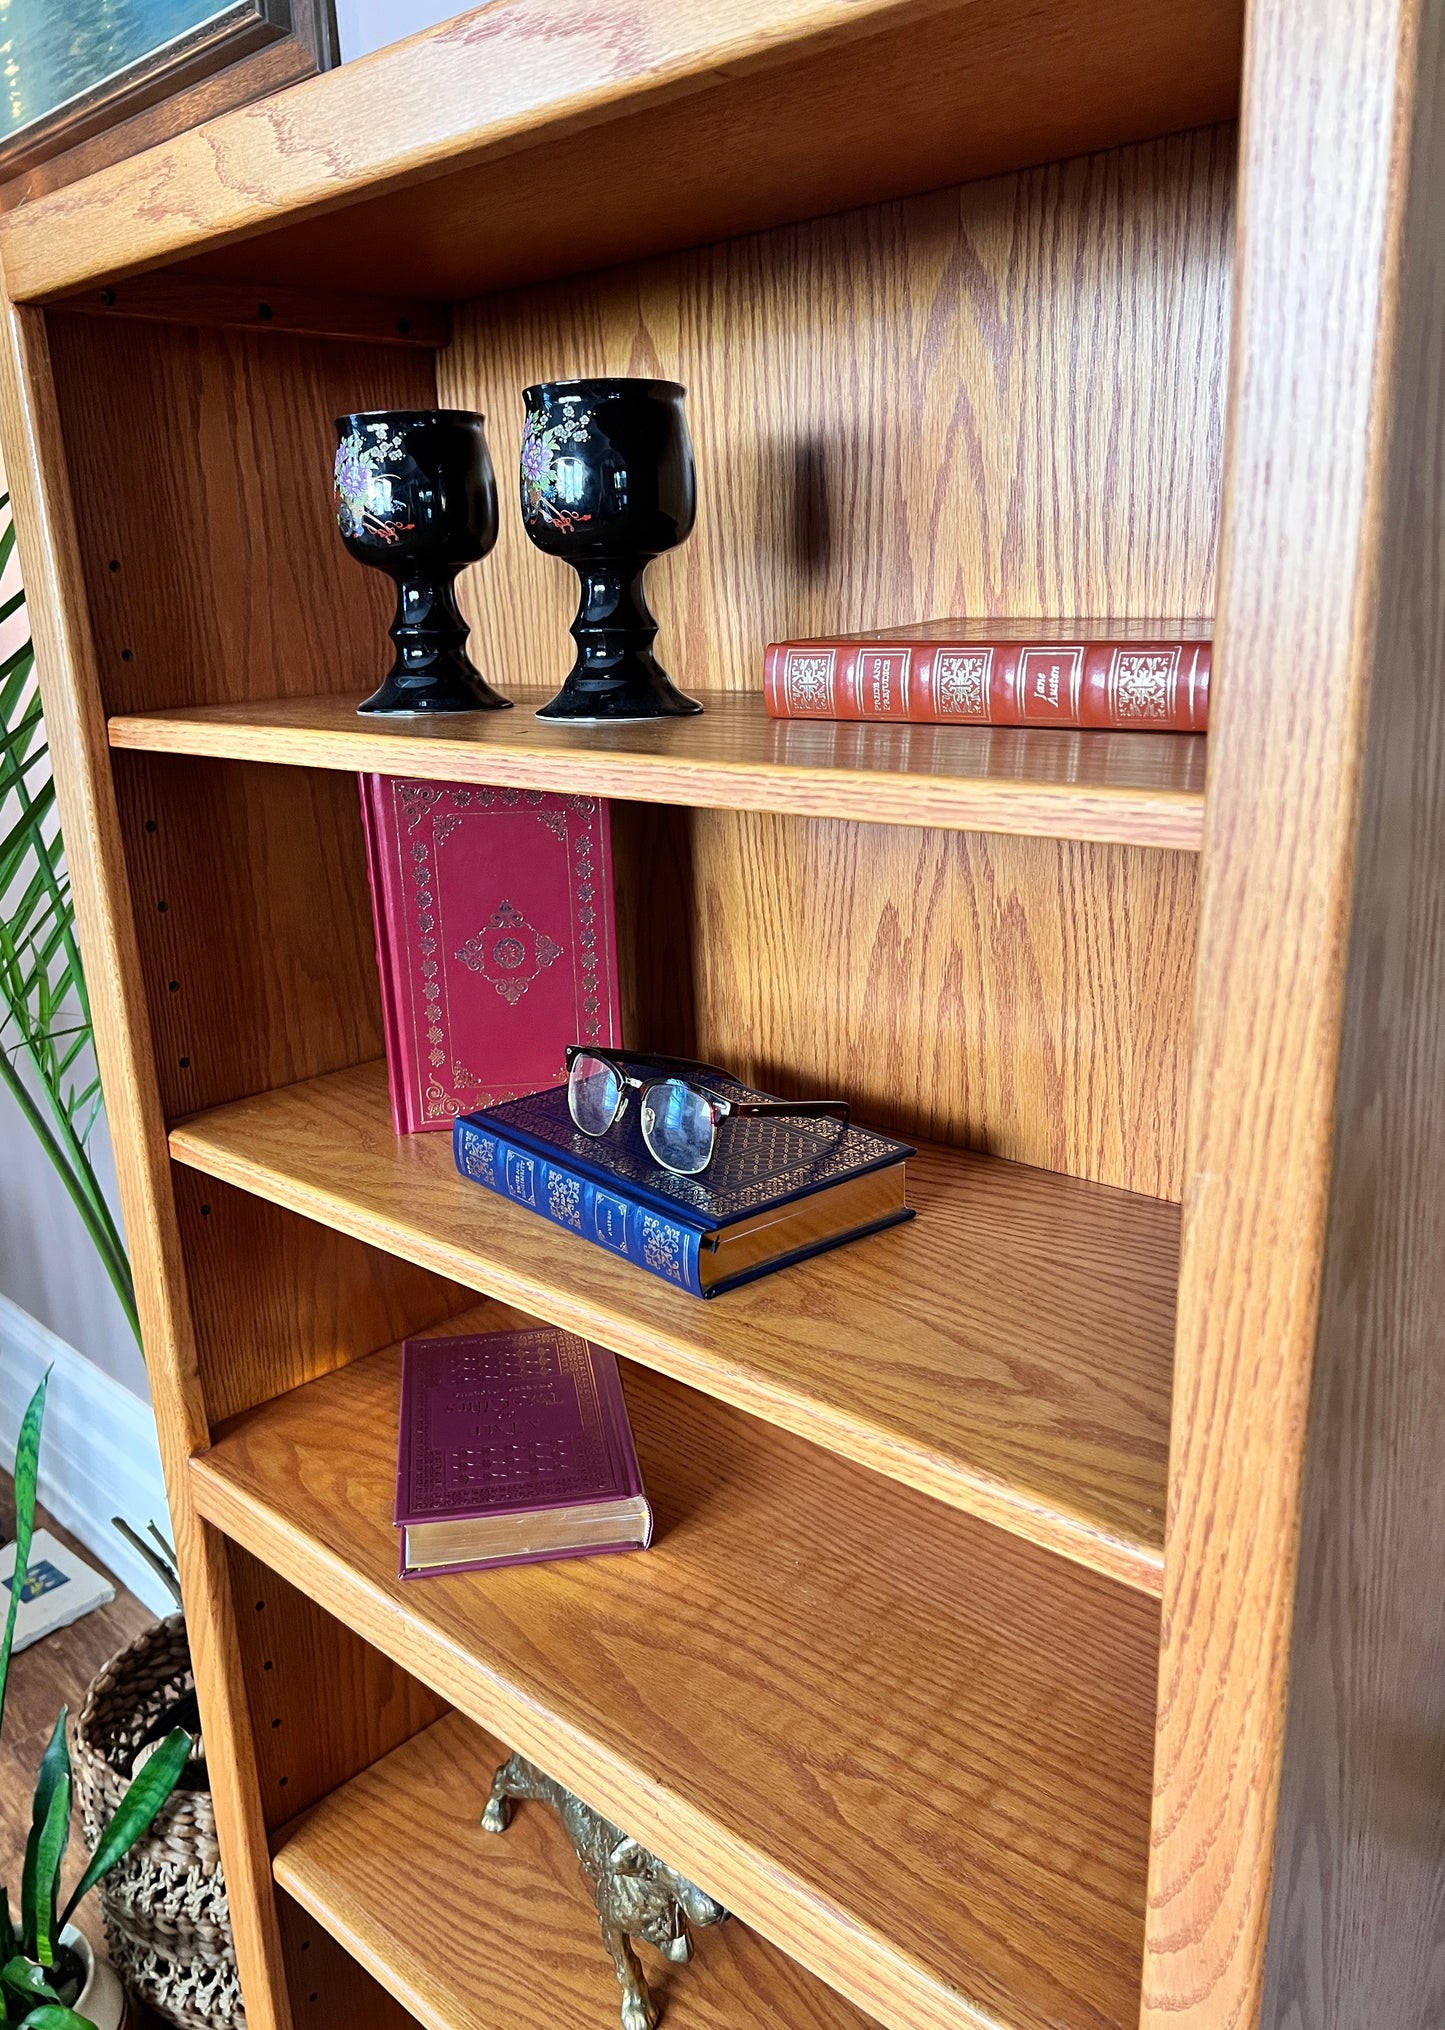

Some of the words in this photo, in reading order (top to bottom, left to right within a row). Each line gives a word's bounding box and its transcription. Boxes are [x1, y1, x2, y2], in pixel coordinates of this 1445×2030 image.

[873, 658, 881, 681] AND
[873, 682, 881, 711] PRIDE
[882, 659, 891, 711] PREJUDICE
[1033, 673, 1047, 701] Jane
[1047, 666, 1060, 708] Austen
